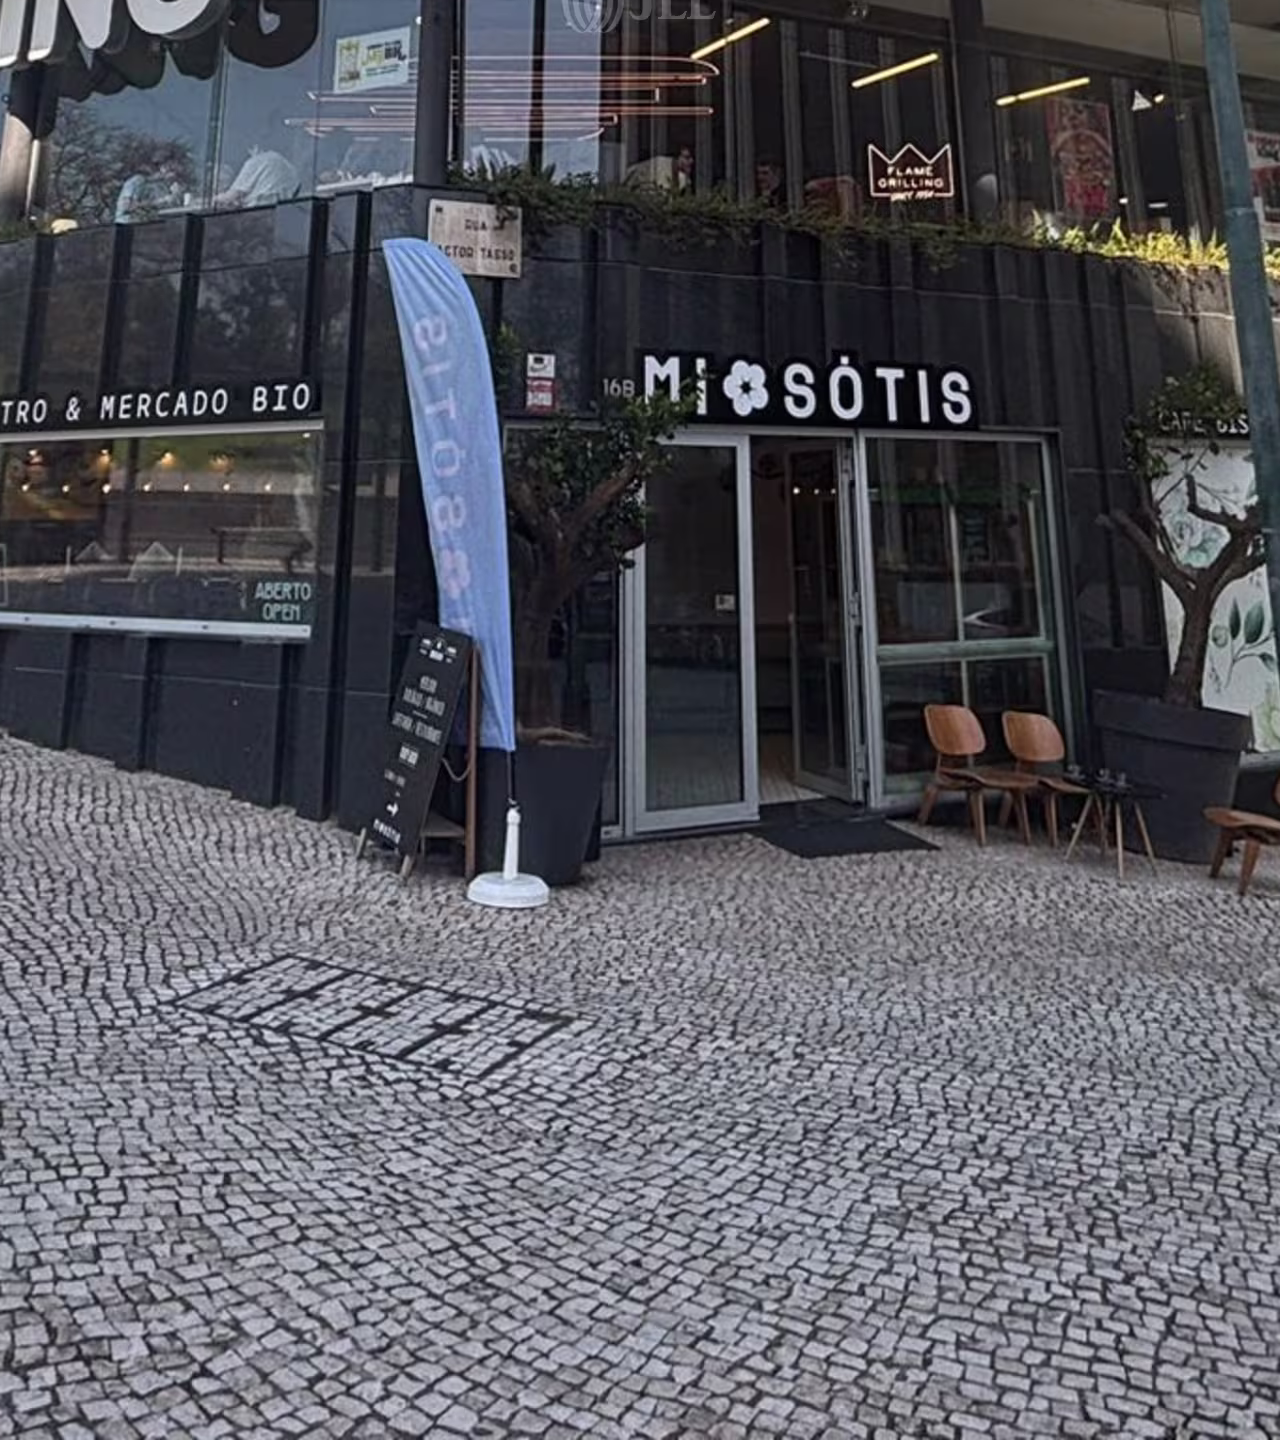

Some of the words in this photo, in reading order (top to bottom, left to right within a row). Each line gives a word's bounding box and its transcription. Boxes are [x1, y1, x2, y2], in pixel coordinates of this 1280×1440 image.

[887, 166, 934, 177] FLAME
[877, 177, 945, 189] GRILLING
[464, 219, 487, 231] RUA
[602, 377, 635, 398] 16B
[65, 396, 81, 423] &
[99, 388, 229, 420] MERCADO
[251, 383, 313, 413] BIO
[254, 581, 312, 601] ABERTO
[262, 602, 301, 621] OPEN
